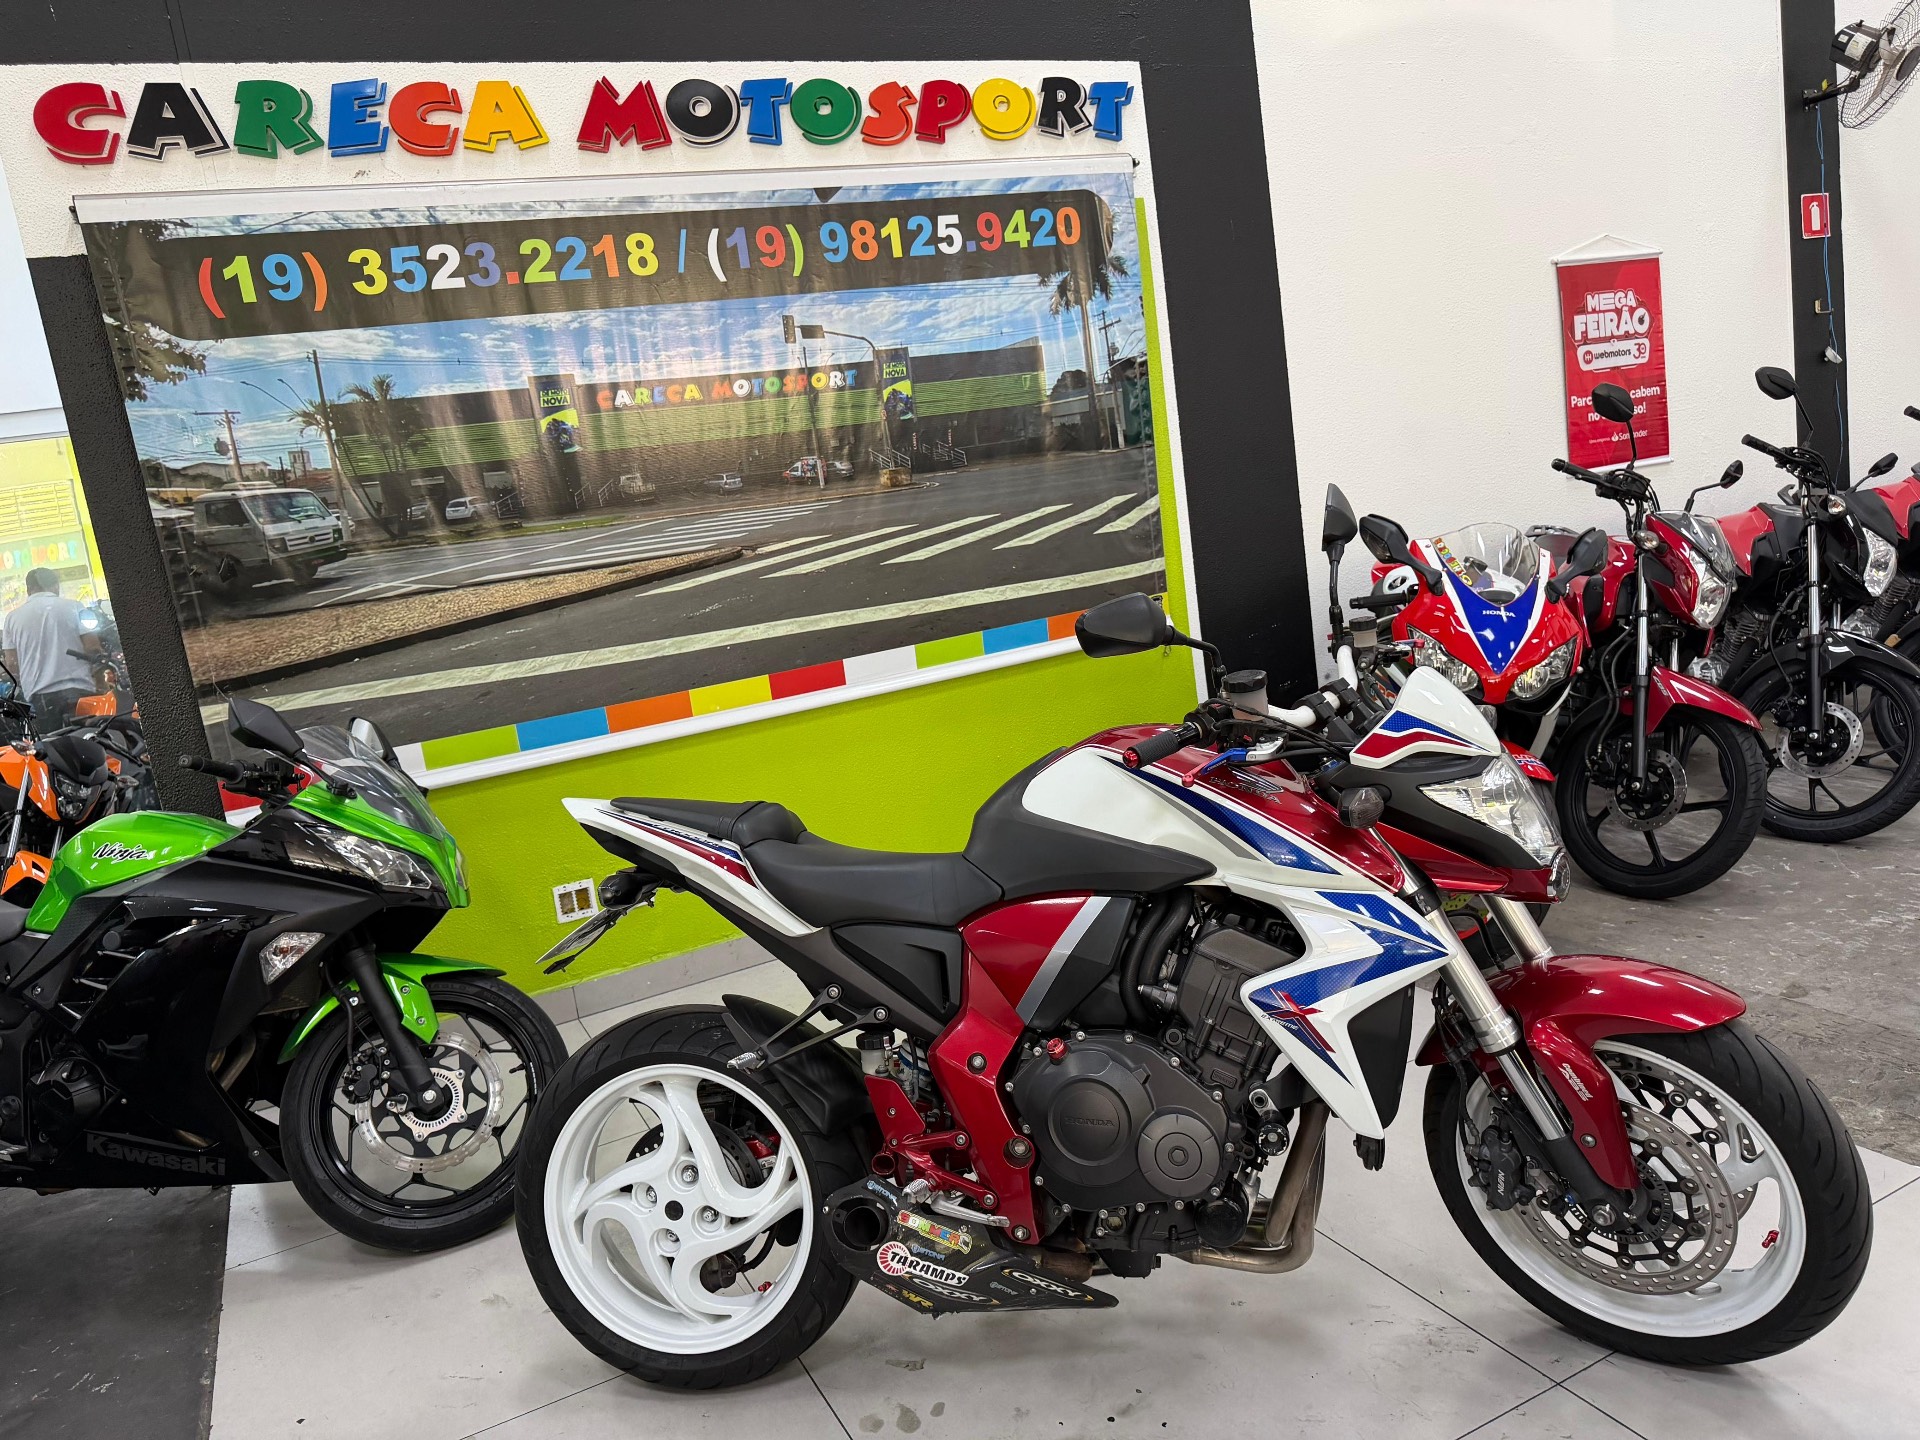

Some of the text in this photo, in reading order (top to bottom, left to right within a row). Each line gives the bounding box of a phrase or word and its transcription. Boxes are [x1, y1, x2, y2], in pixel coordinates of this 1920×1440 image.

[33, 76, 1133, 165] CARECA MOTOSPORT
[198, 251, 328, 319] (19)
[348, 232, 659, 295] 3523.2218
[708, 223, 804, 282] (19)
[820, 206, 1081, 263] 98125.9420
[1586, 291, 1636, 312] MEGA
[1574, 306, 1650, 340] FEIRÃO
[1594, 348, 1631, 360] webmotors
[884, 368, 906, 377] NOVA
[542, 396, 569, 406] NOVA
[597, 369, 858, 409] CARECA MOTOSPORT
[1630, 386, 1660, 398] cabem
[1482, 610, 1516, 618] HONDA
[93, 842, 148, 864] Ninja
[86, 1133, 226, 1176] Kawasaki
[900, 1212, 960, 1246] SOMMER
[890, 1251, 966, 1285] TARAMPS
